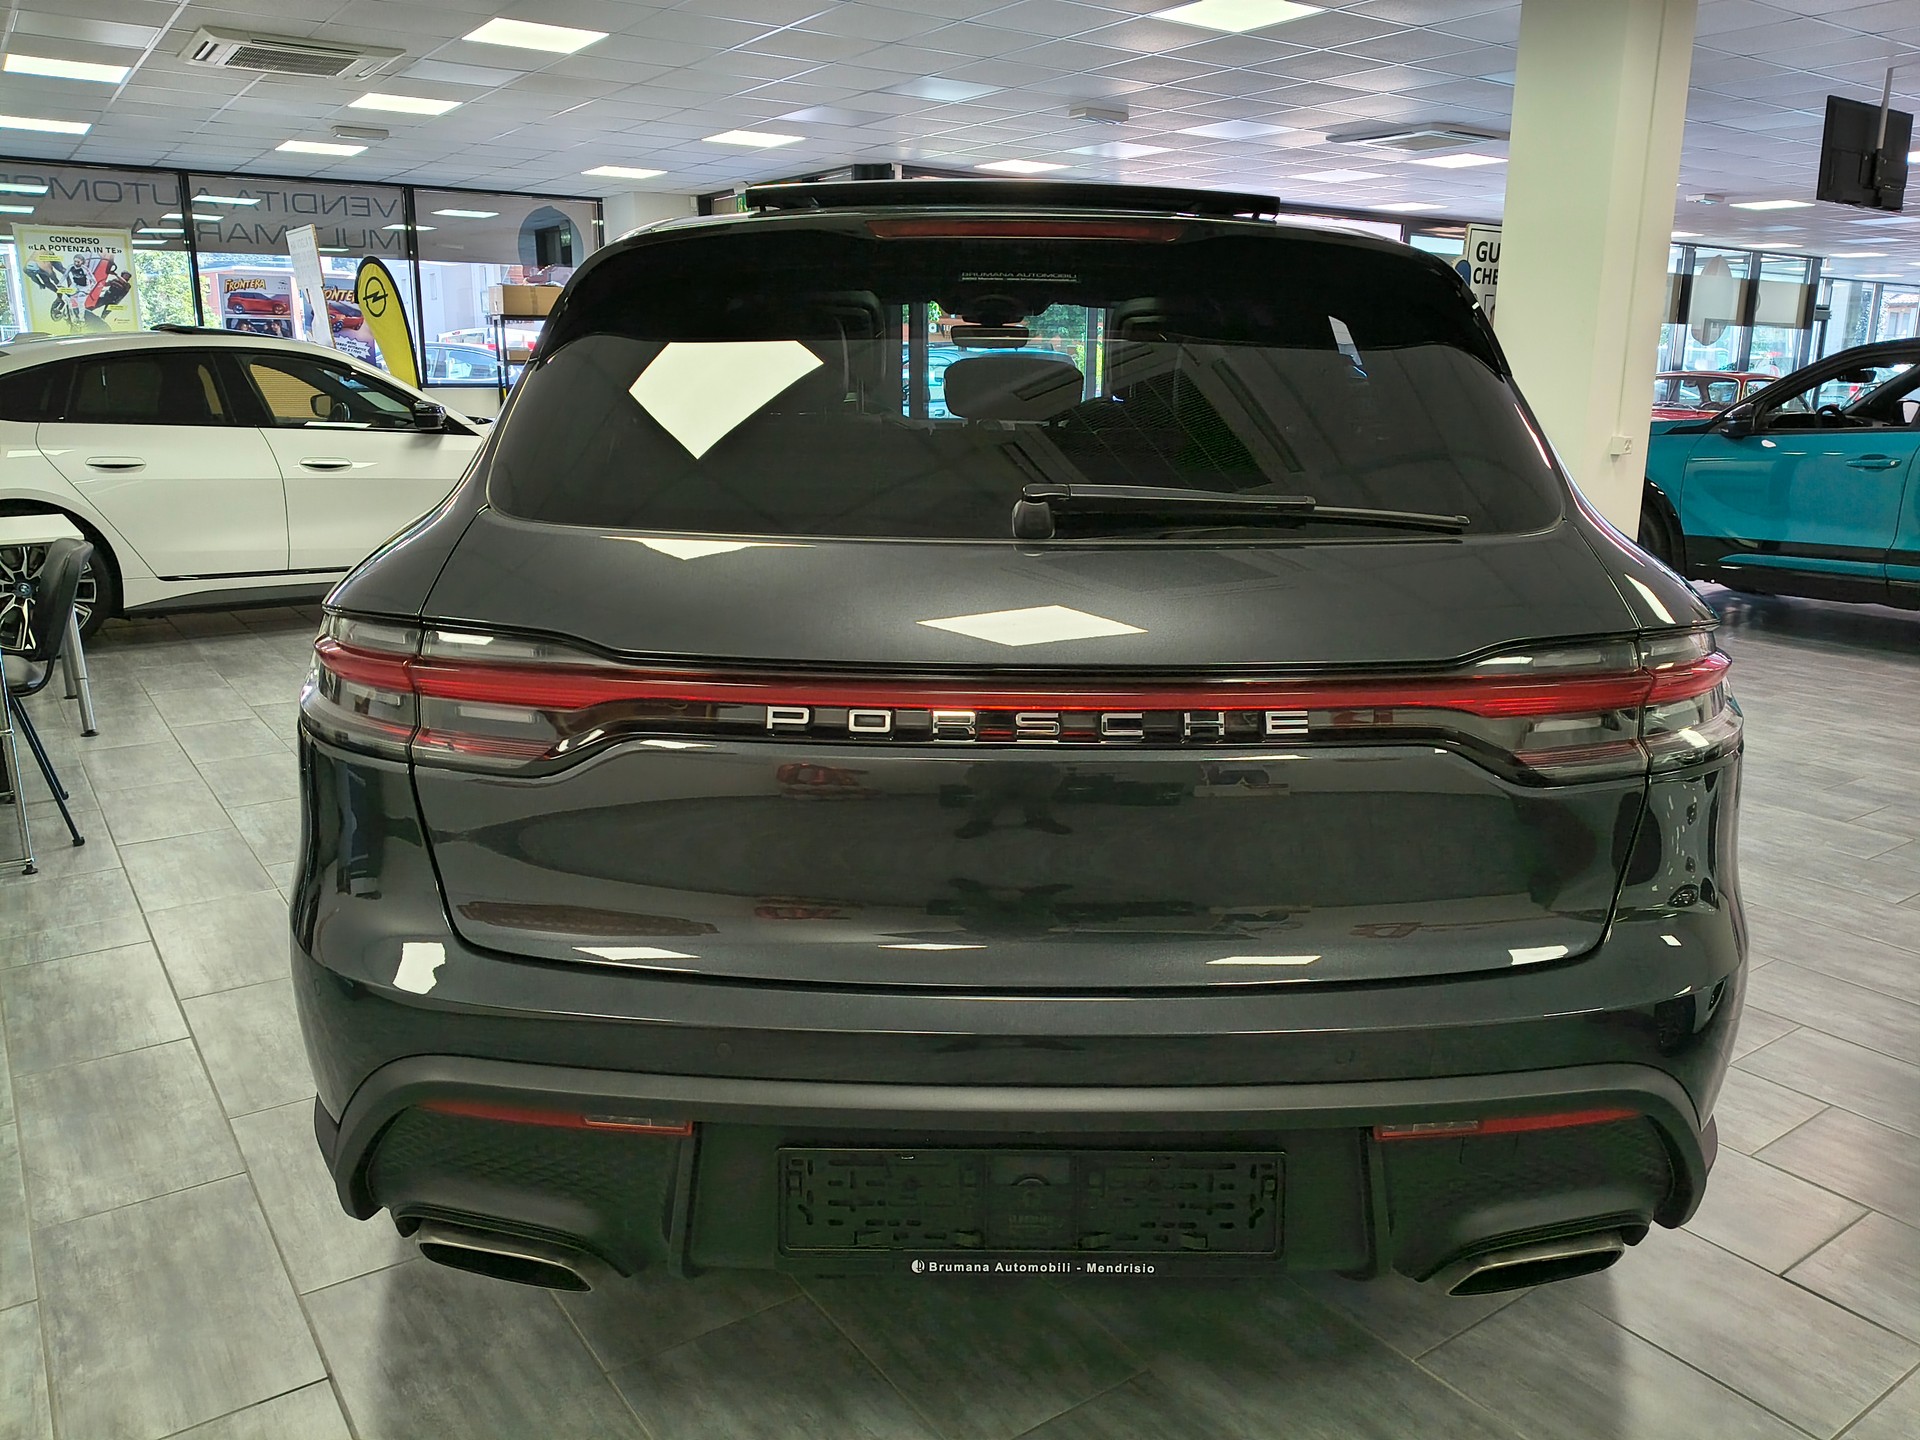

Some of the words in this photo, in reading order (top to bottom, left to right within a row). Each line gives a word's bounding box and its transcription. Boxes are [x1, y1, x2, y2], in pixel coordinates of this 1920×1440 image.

[49, 235, 100, 245] CONCORSO
[48, 244, 91, 253] POTENZA
[1476, 241, 1501, 263] GU
[224, 278, 266, 293] FRONTERA
[324, 286, 355, 302] ONTE
[766, 705, 1309, 736] PORSCHE
[928, 1262, 990, 1272] Brumana
[994, 1262, 1071, 1273] Automobili
[1086, 1262, 1155, 1273] Mendrisio
